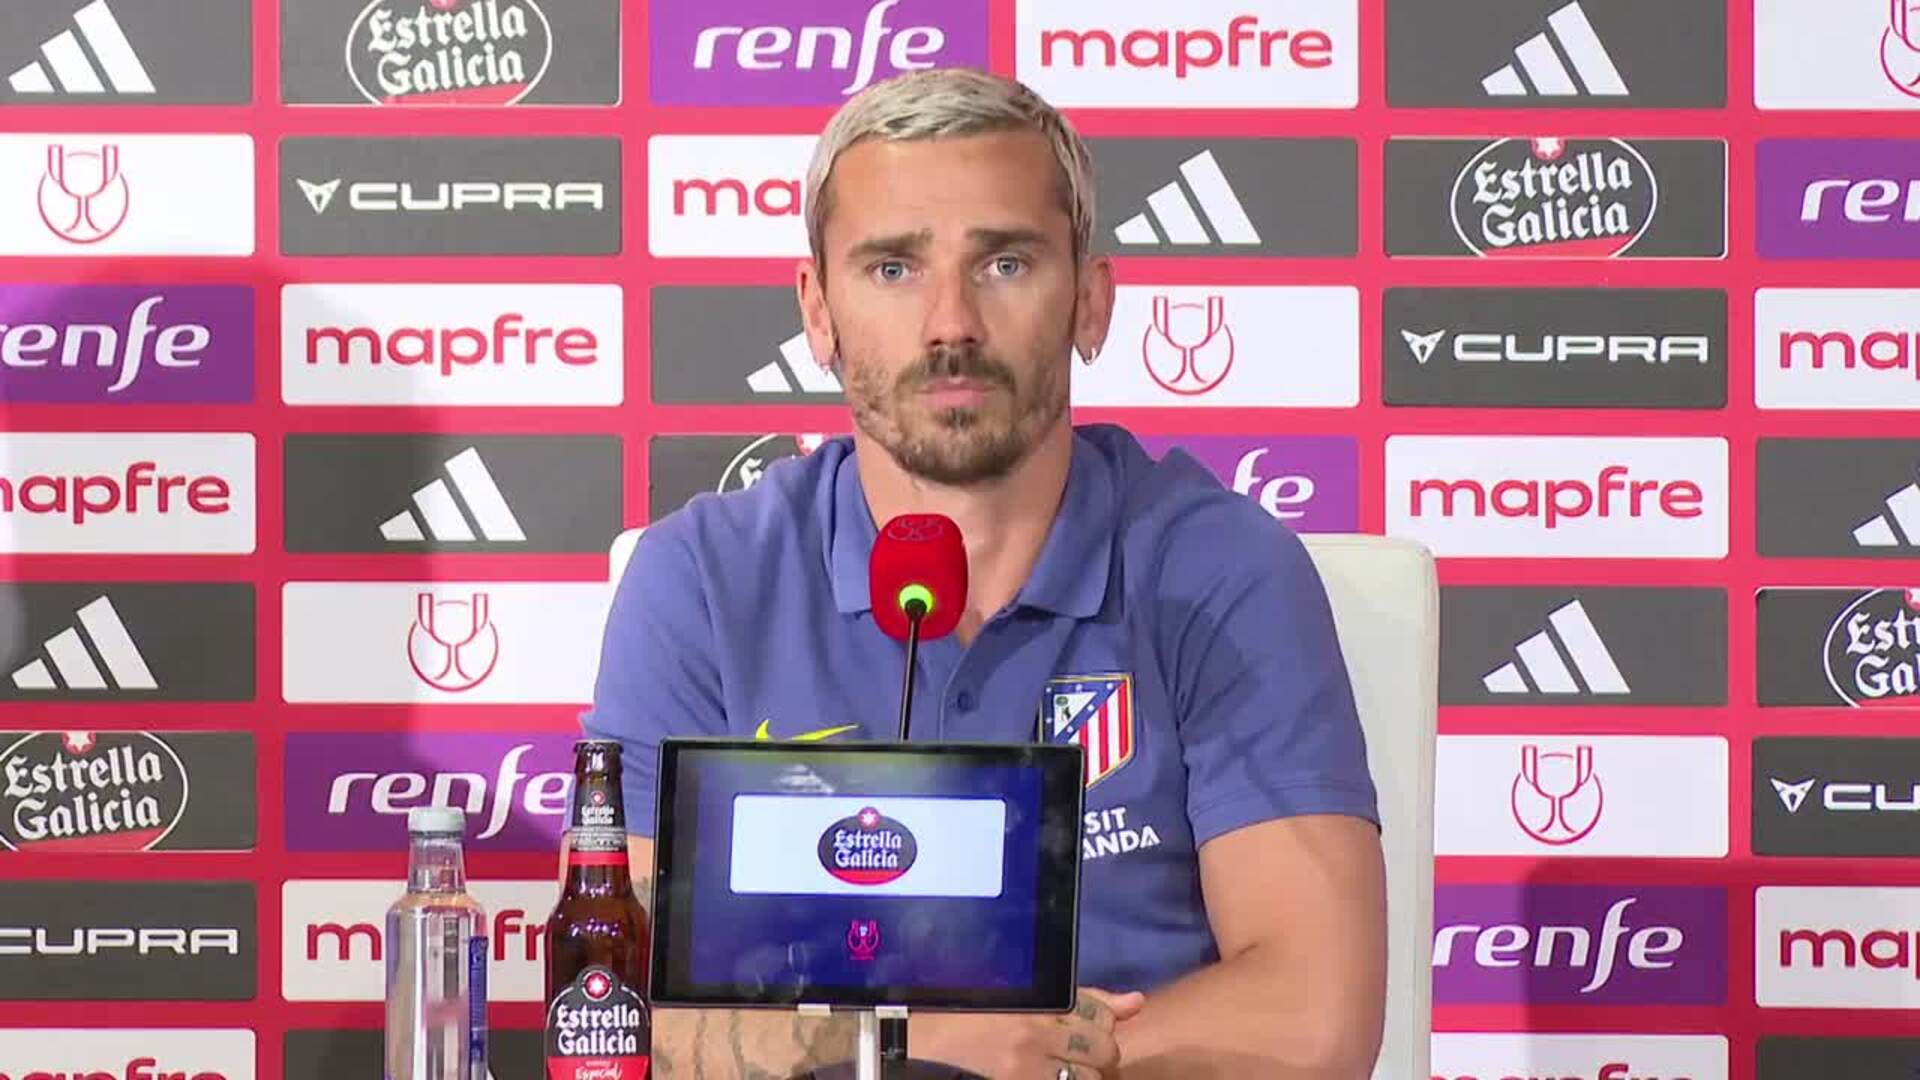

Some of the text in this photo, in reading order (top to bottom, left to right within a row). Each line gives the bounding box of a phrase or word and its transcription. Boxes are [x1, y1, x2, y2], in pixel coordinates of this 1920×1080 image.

[367, 0, 528, 52] Estrella
[693, 0, 945, 95] renfe
[1041, 15, 1334, 79] mapfre
[377, 42, 525, 96] Galicia
[349, 182, 604, 212] CUPRA
[1472, 151, 1633, 204] Estrella
[1482, 194, 1630, 247] Galicia
[0, 296, 210, 393] enfe
[306, 313, 599, 376] mapfre
[1454, 335, 1709, 364] CUPRA
[1779, 331, 1920, 381] ma
[0, 461, 231, 525] apfre
[1410, 465, 1704, 529] mapfre
[1855, 653, 1920, 697] Ga
[4, 745, 164, 798] Estrella
[327, 743, 569, 840] renfe
[13, 788, 161, 840] Galicia
[833, 828, 902, 849] Estrella
[835, 848, 898, 868] Galicia
[0, 929, 239, 954] CUPRA
[1431, 897, 1684, 993] renfe
[1780, 929, 1920, 980] ma
[556, 1003, 640, 1029] Estrella
[558, 1028, 637, 1055] Galicia
